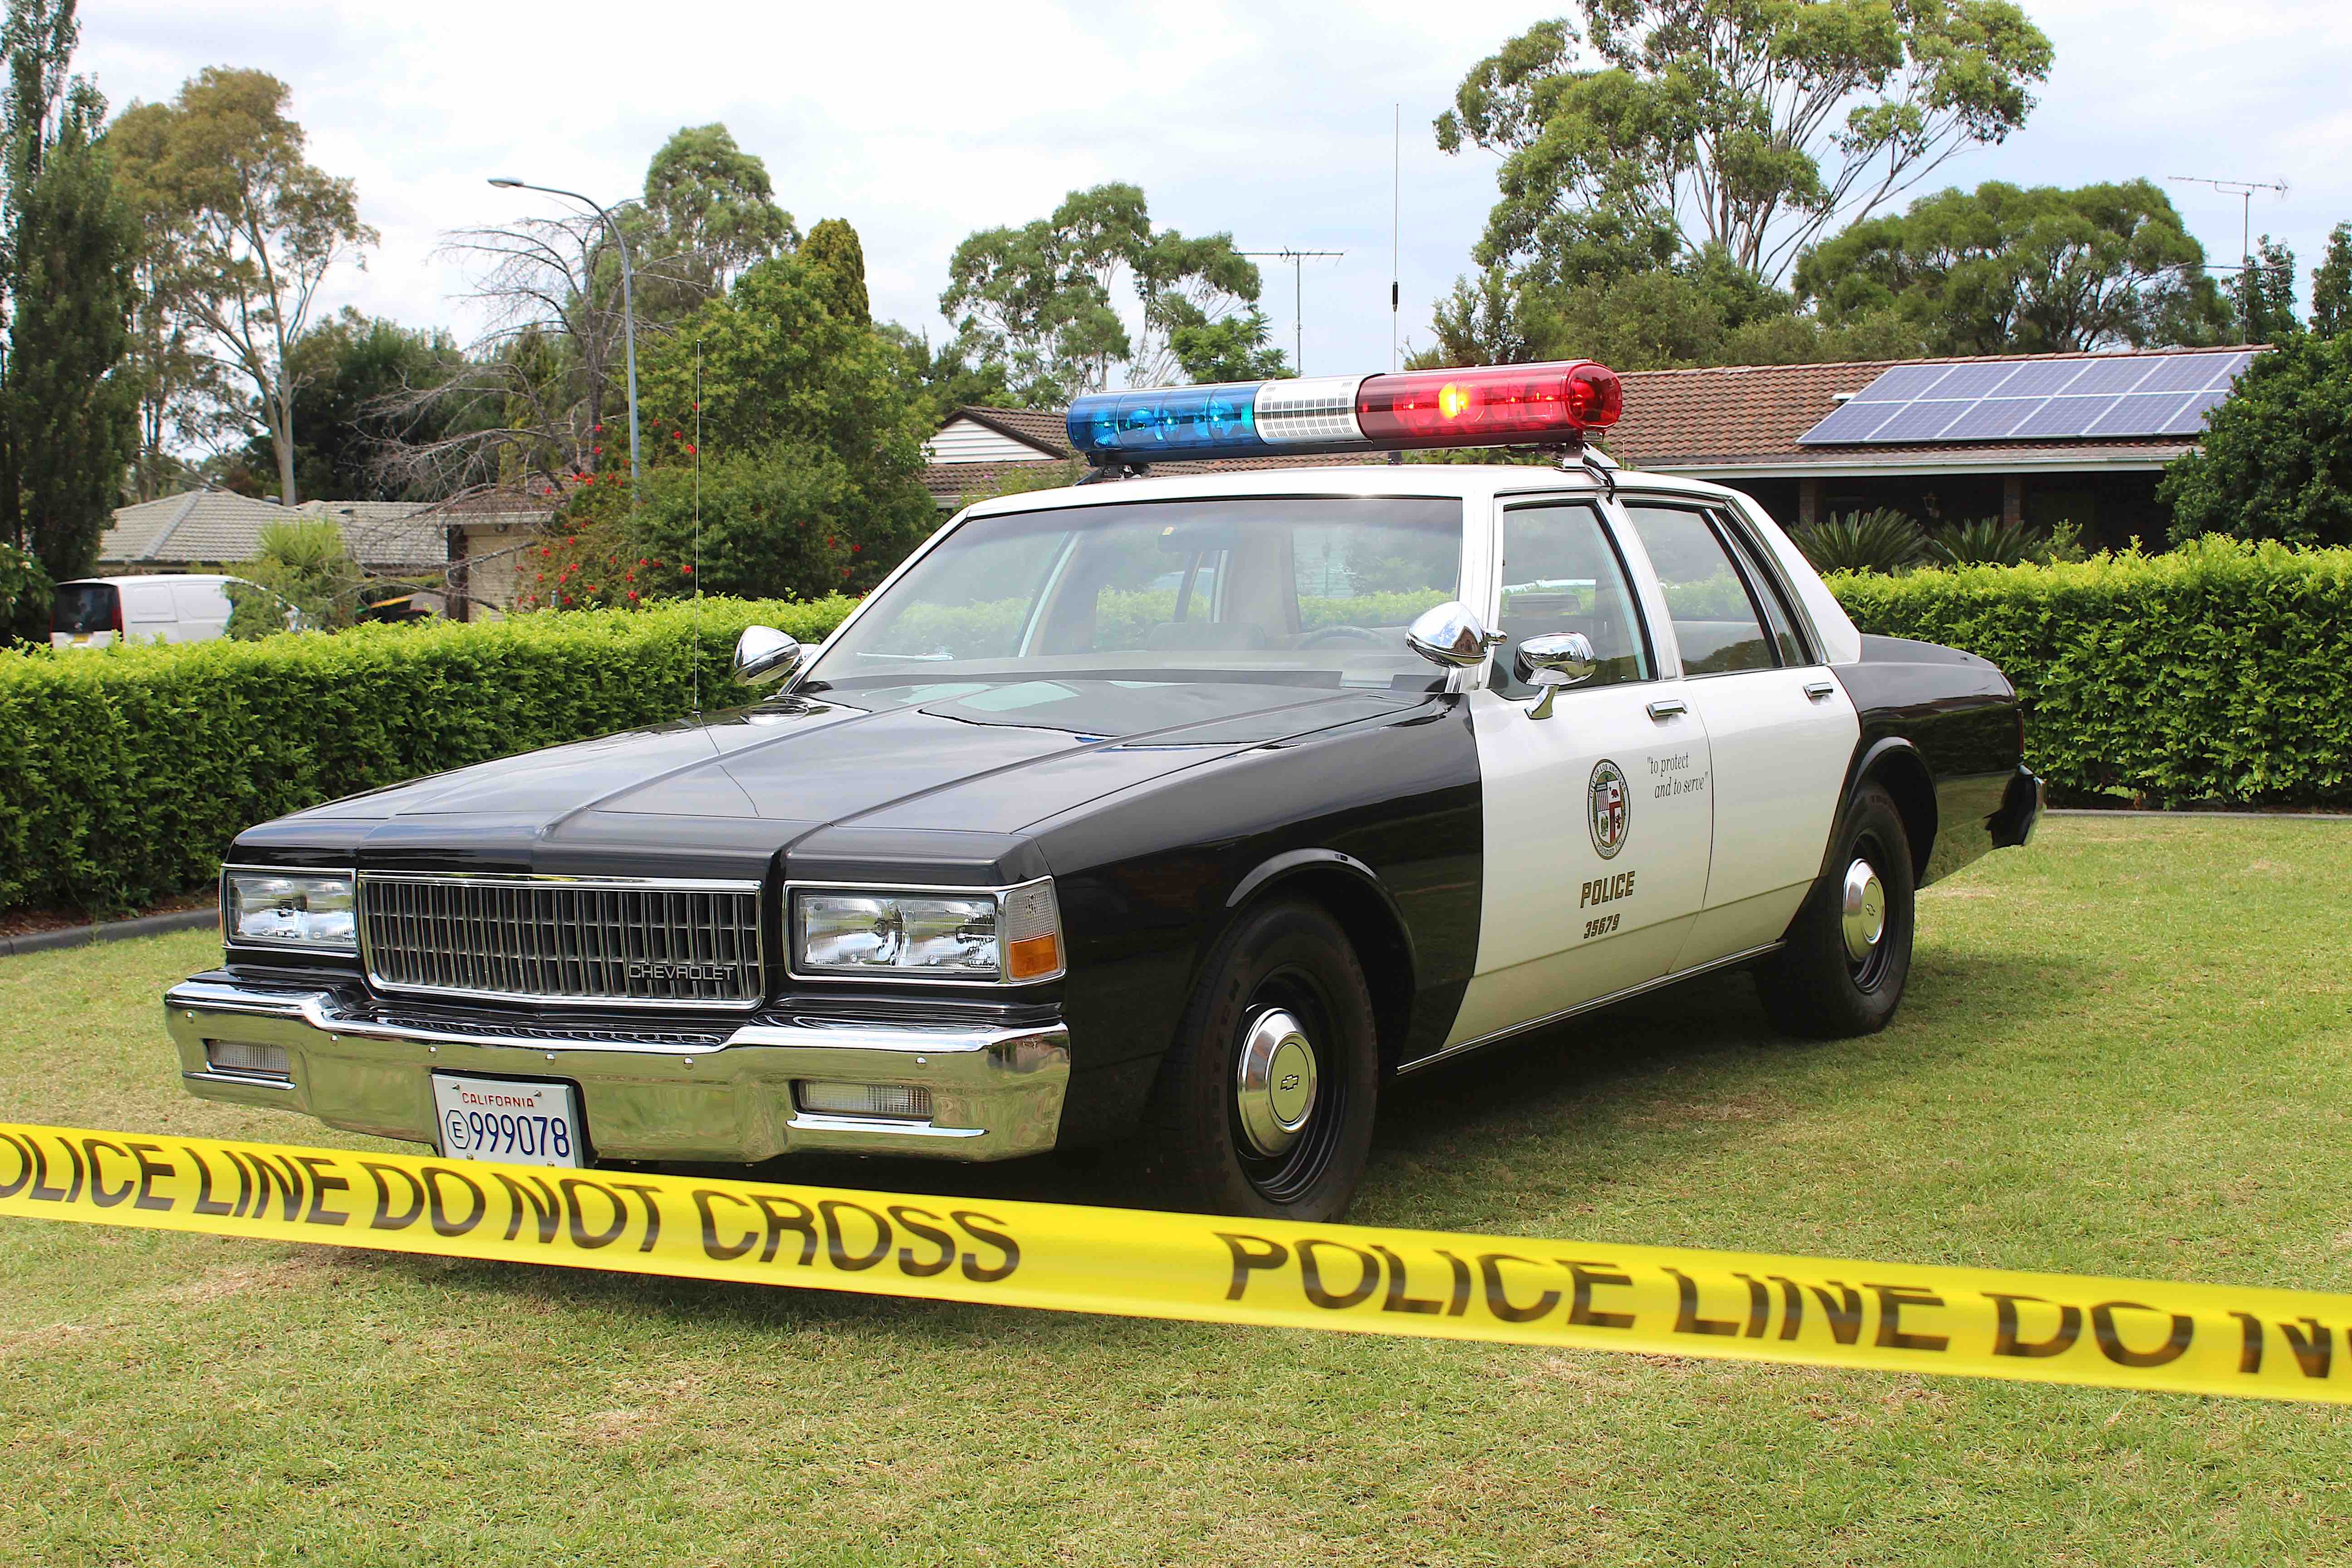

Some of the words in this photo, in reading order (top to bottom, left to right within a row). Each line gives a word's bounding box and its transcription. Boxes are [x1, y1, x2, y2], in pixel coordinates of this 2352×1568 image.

[1661, 751, 1688, 777] protect
[1655, 776, 1671, 799] and
[1674, 778, 1681, 794] to
[1580, 871, 1635, 908] POLICE
[1583, 913, 1620, 939] 35679
[628, 965, 734, 980] CHEVROLET
[462, 1092, 534, 1107] CALIFORNIA
[469, 1112, 570, 1157] 999078
[183, 1147, 350, 1226] LINE
[359, 1162, 486, 1237] DO
[492, 1173, 661, 1253] NOT
[692, 1190, 1020, 1283] CROSS
[1212, 1232, 1636, 1329] POLICE
[1661, 1267, 1950, 1352] LINE
[1981, 1292, 2195, 1368] DO
[2229, 1312, 2352, 1379] N
